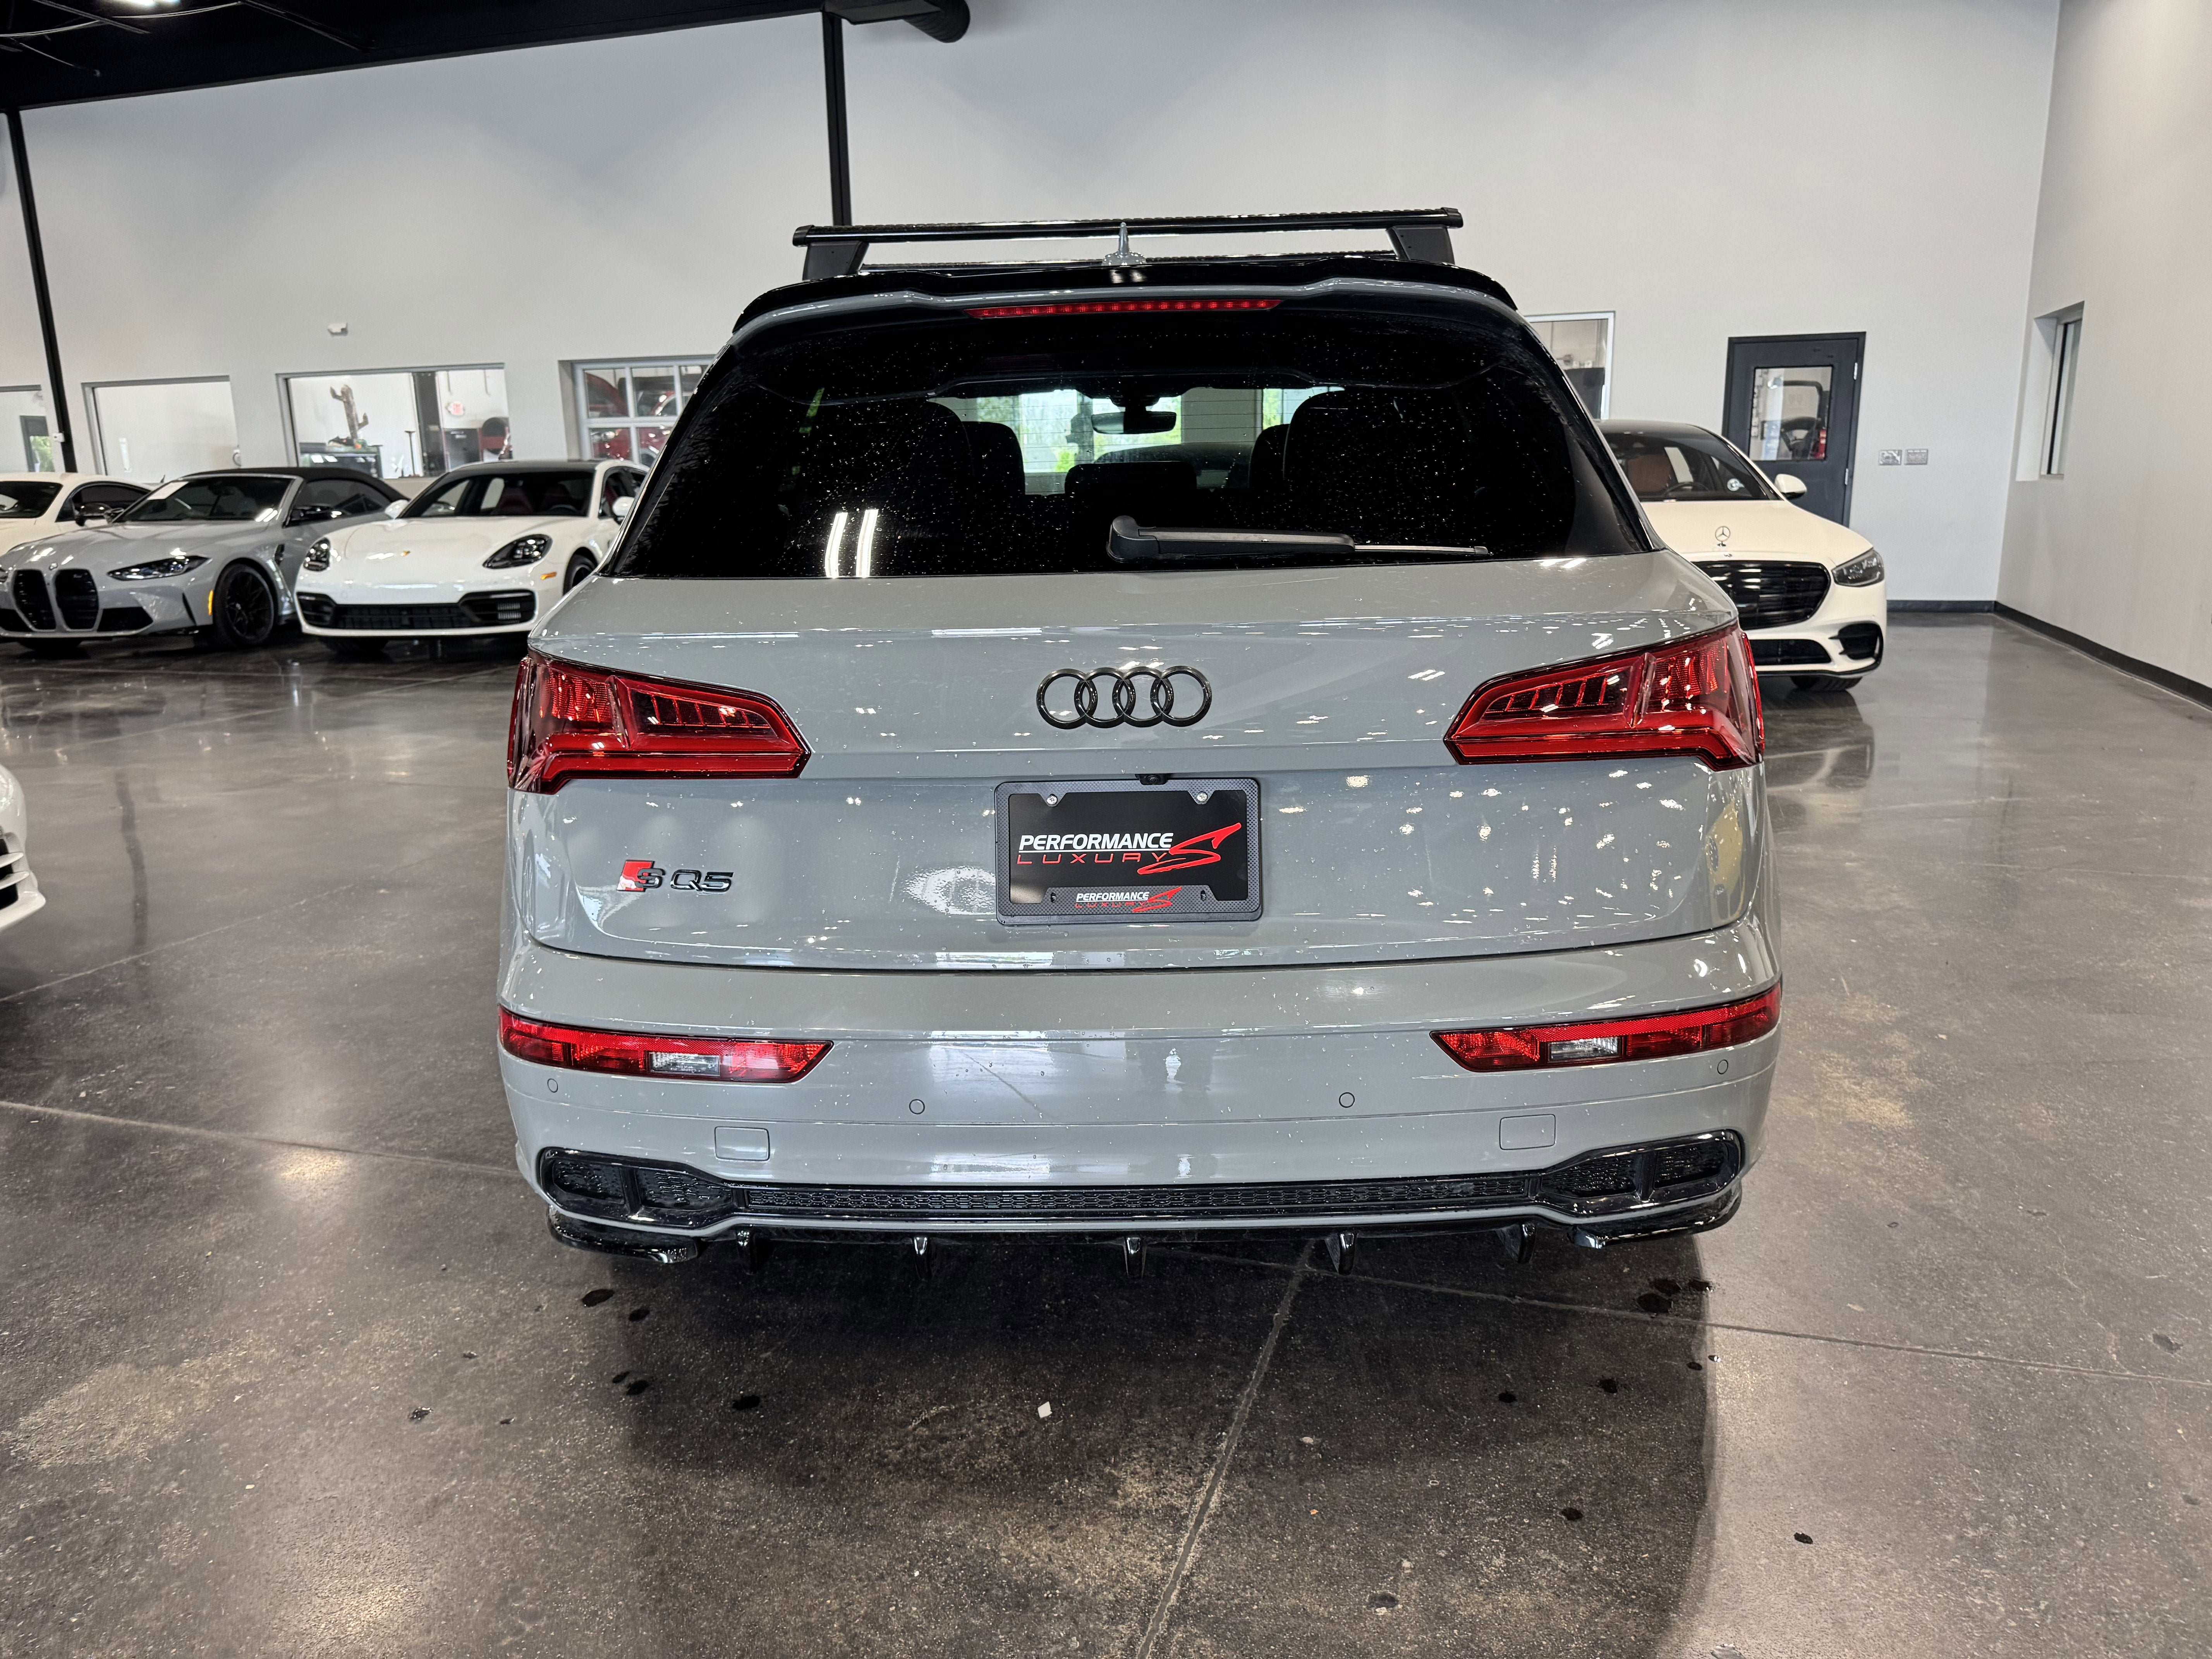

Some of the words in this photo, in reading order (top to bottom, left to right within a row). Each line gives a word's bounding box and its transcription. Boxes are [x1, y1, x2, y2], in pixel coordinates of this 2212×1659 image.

[1019, 833, 1174, 850] PERFORMANCE
[1017, 852, 1167, 865] LUXURY
[635, 867, 734, 893] SQ5
[1076, 891, 1150, 901] PERFORMANCE
